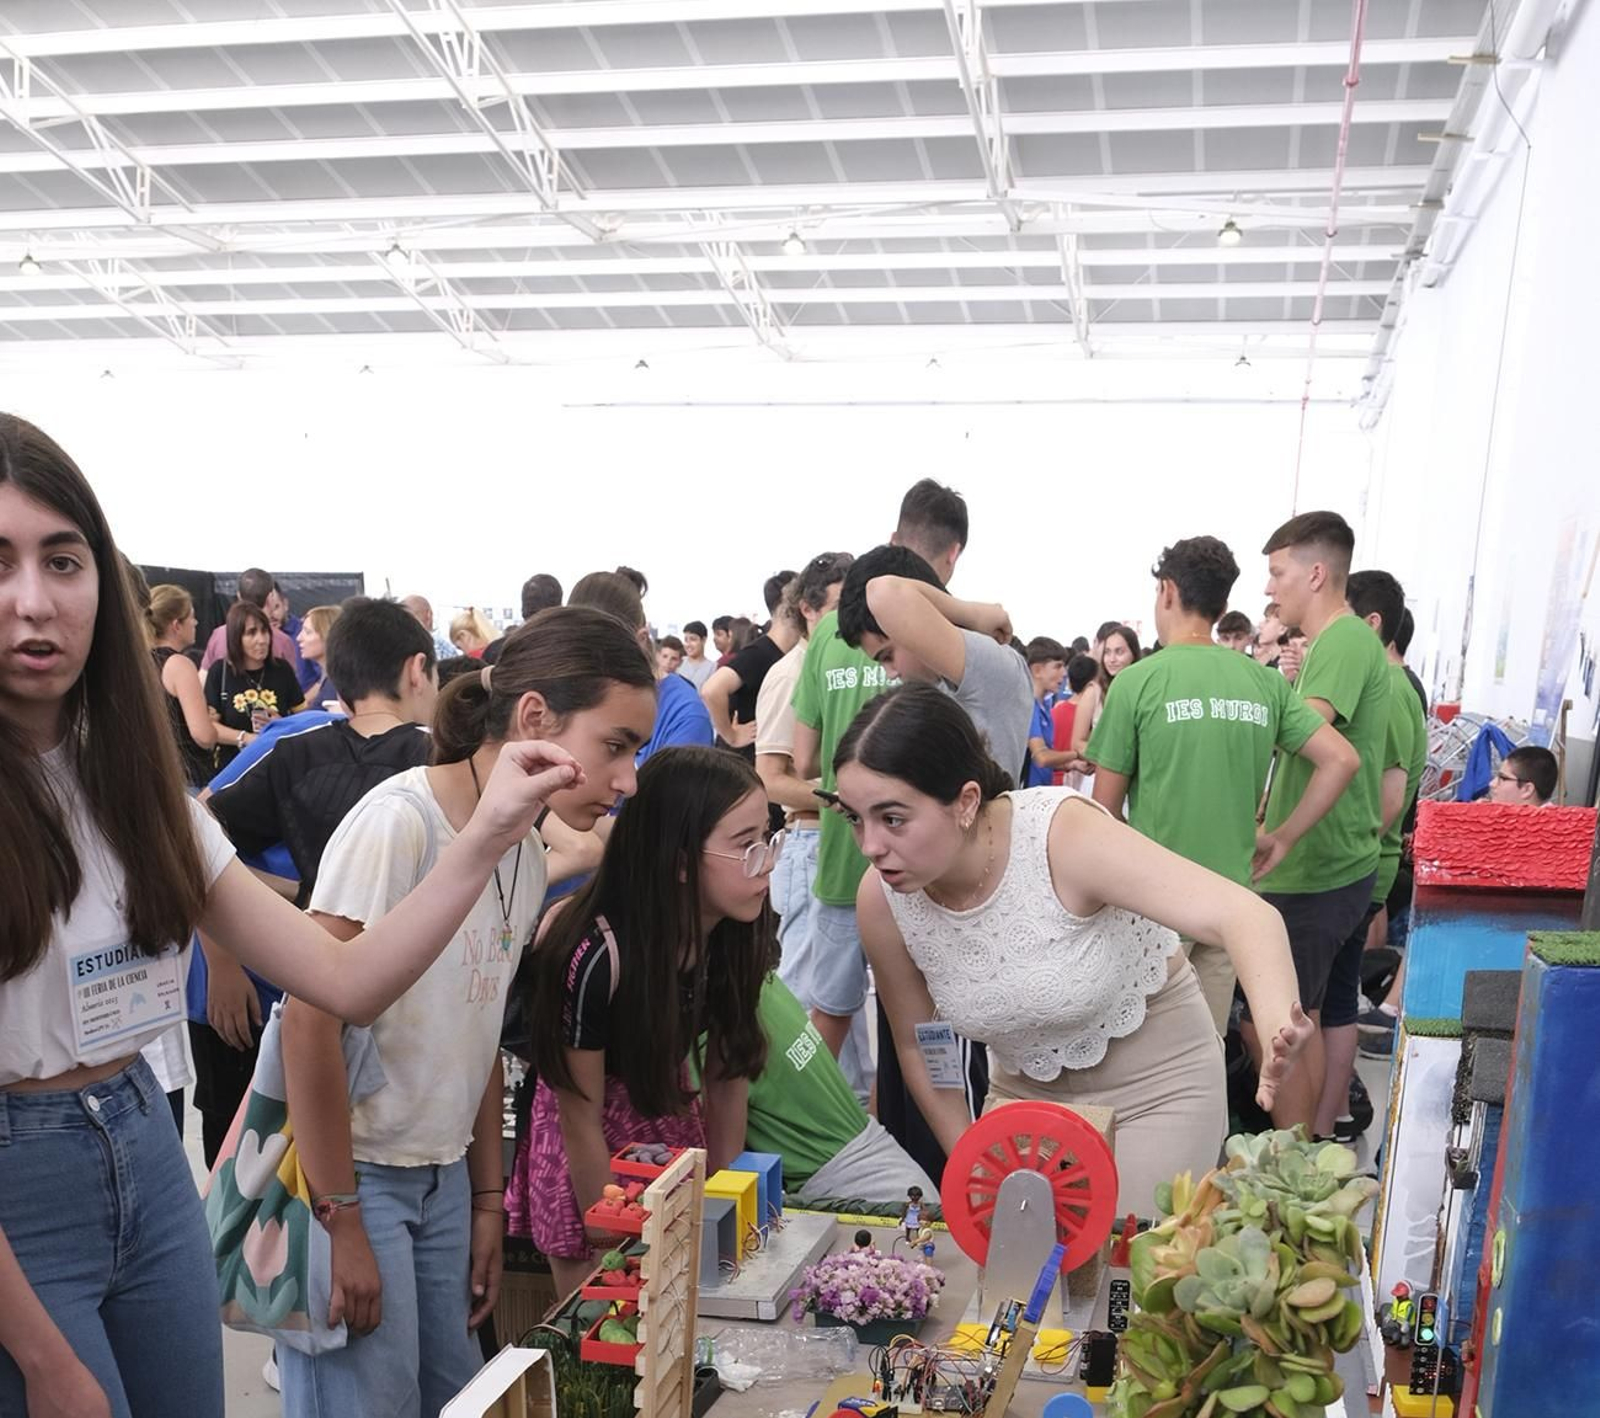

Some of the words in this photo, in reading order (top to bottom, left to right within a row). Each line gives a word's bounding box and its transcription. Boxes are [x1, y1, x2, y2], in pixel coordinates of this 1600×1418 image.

[825, 667, 858, 691] IES
[1165, 698, 1204, 723] IES
[1209, 697, 1269, 728] MURGI
[76, 944, 170, 978] ESTUDIA
[108, 978, 117, 992] DE
[117, 976, 126, 989] LA
[125, 969, 149, 986] CIENCIA
[785, 1031, 817, 1072] IES
